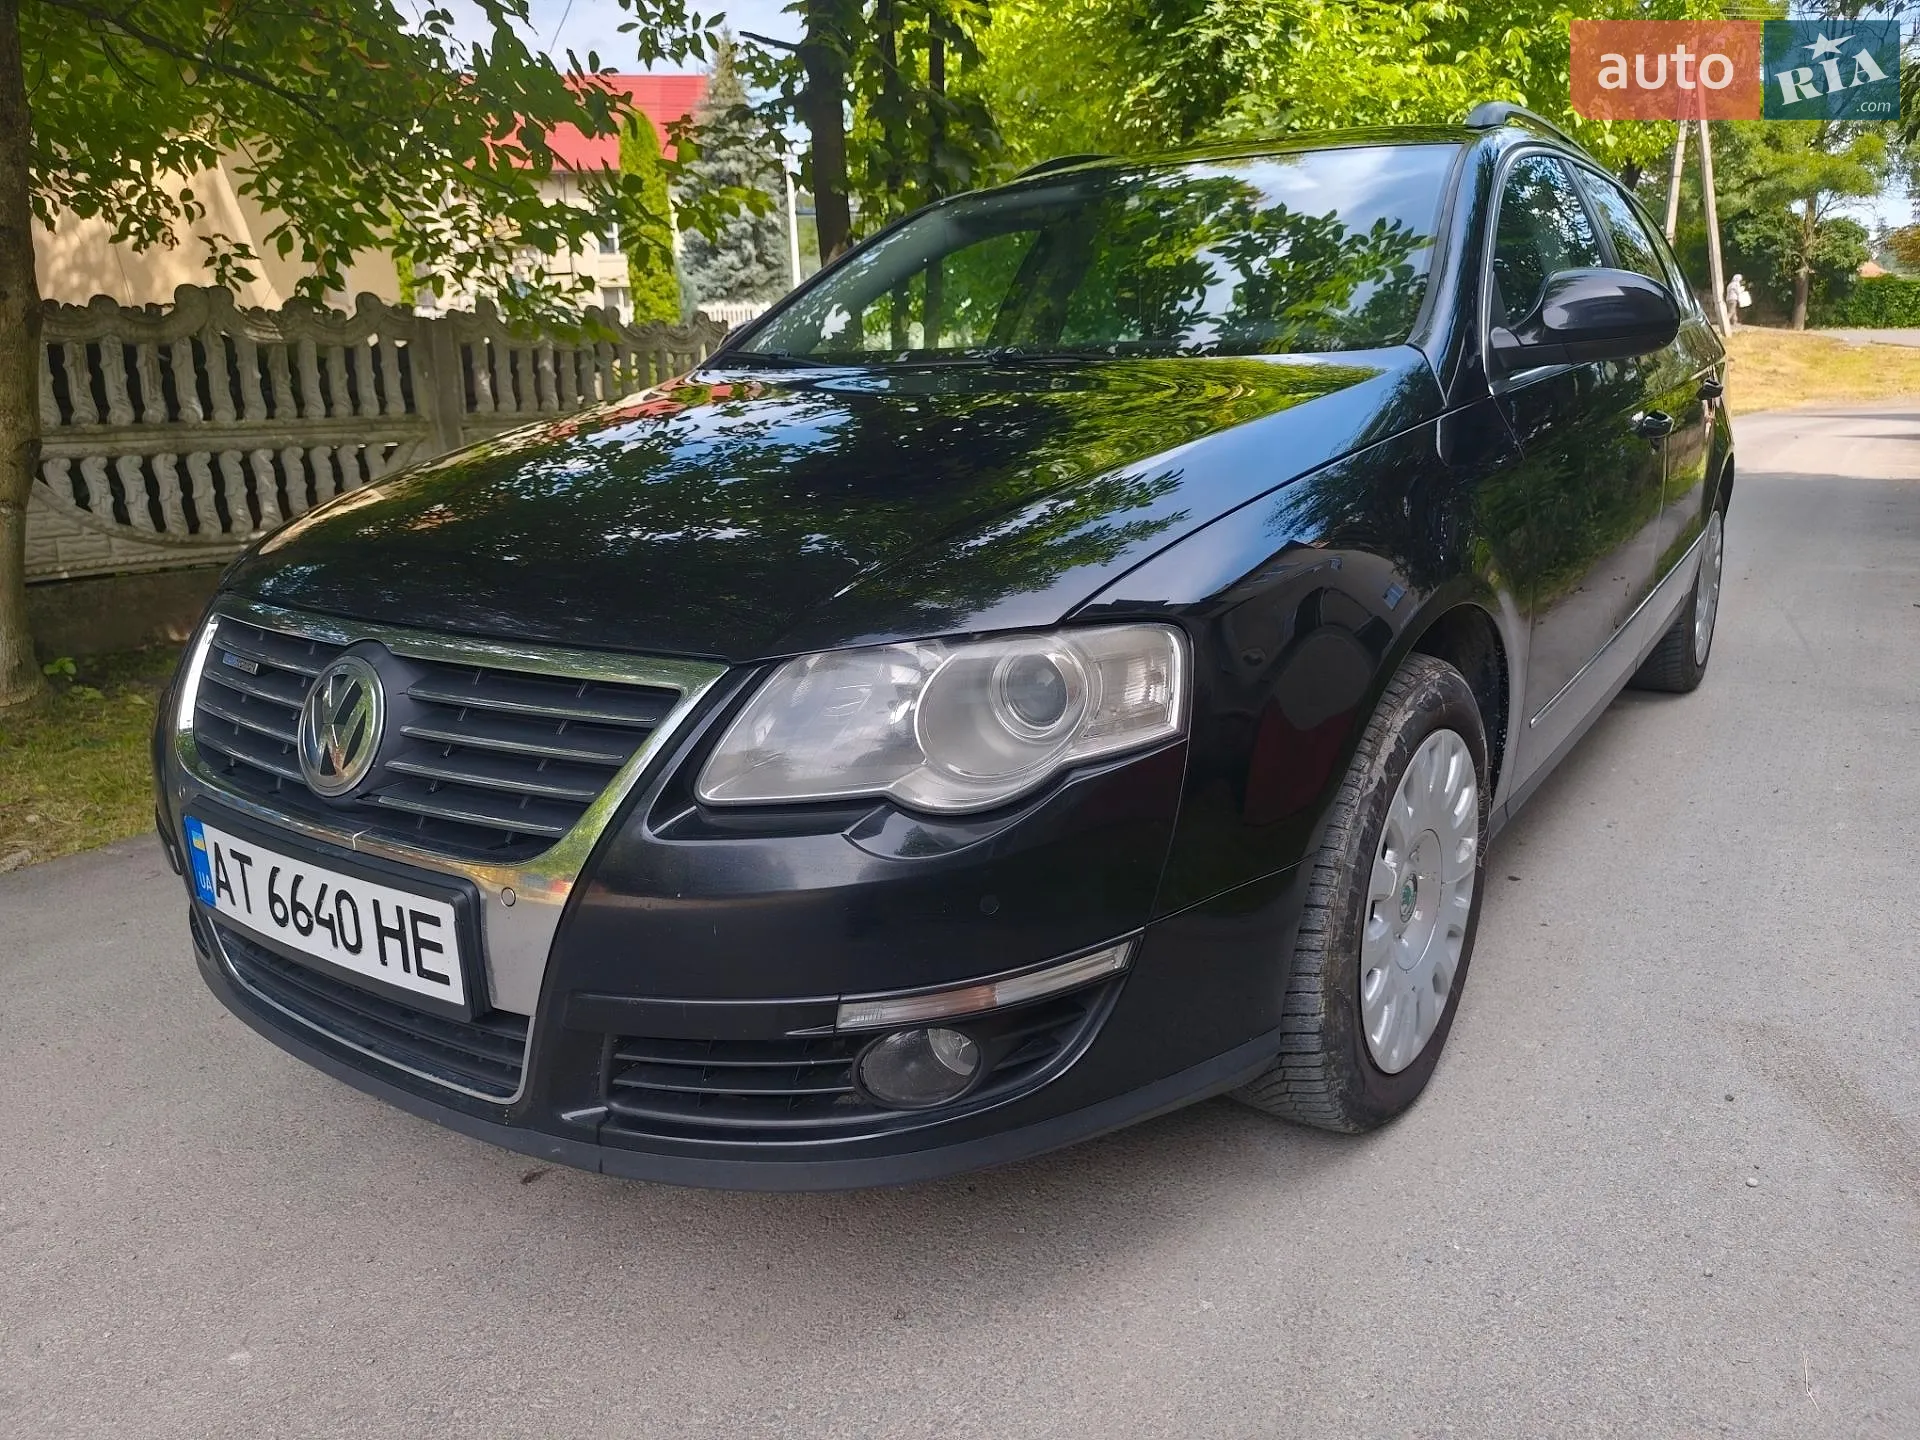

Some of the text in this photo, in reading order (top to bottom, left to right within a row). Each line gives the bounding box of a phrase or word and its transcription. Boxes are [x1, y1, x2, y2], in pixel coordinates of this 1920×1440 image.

[199, 871, 214, 894] UA
[214, 841, 451, 987] AT 6640 HE
